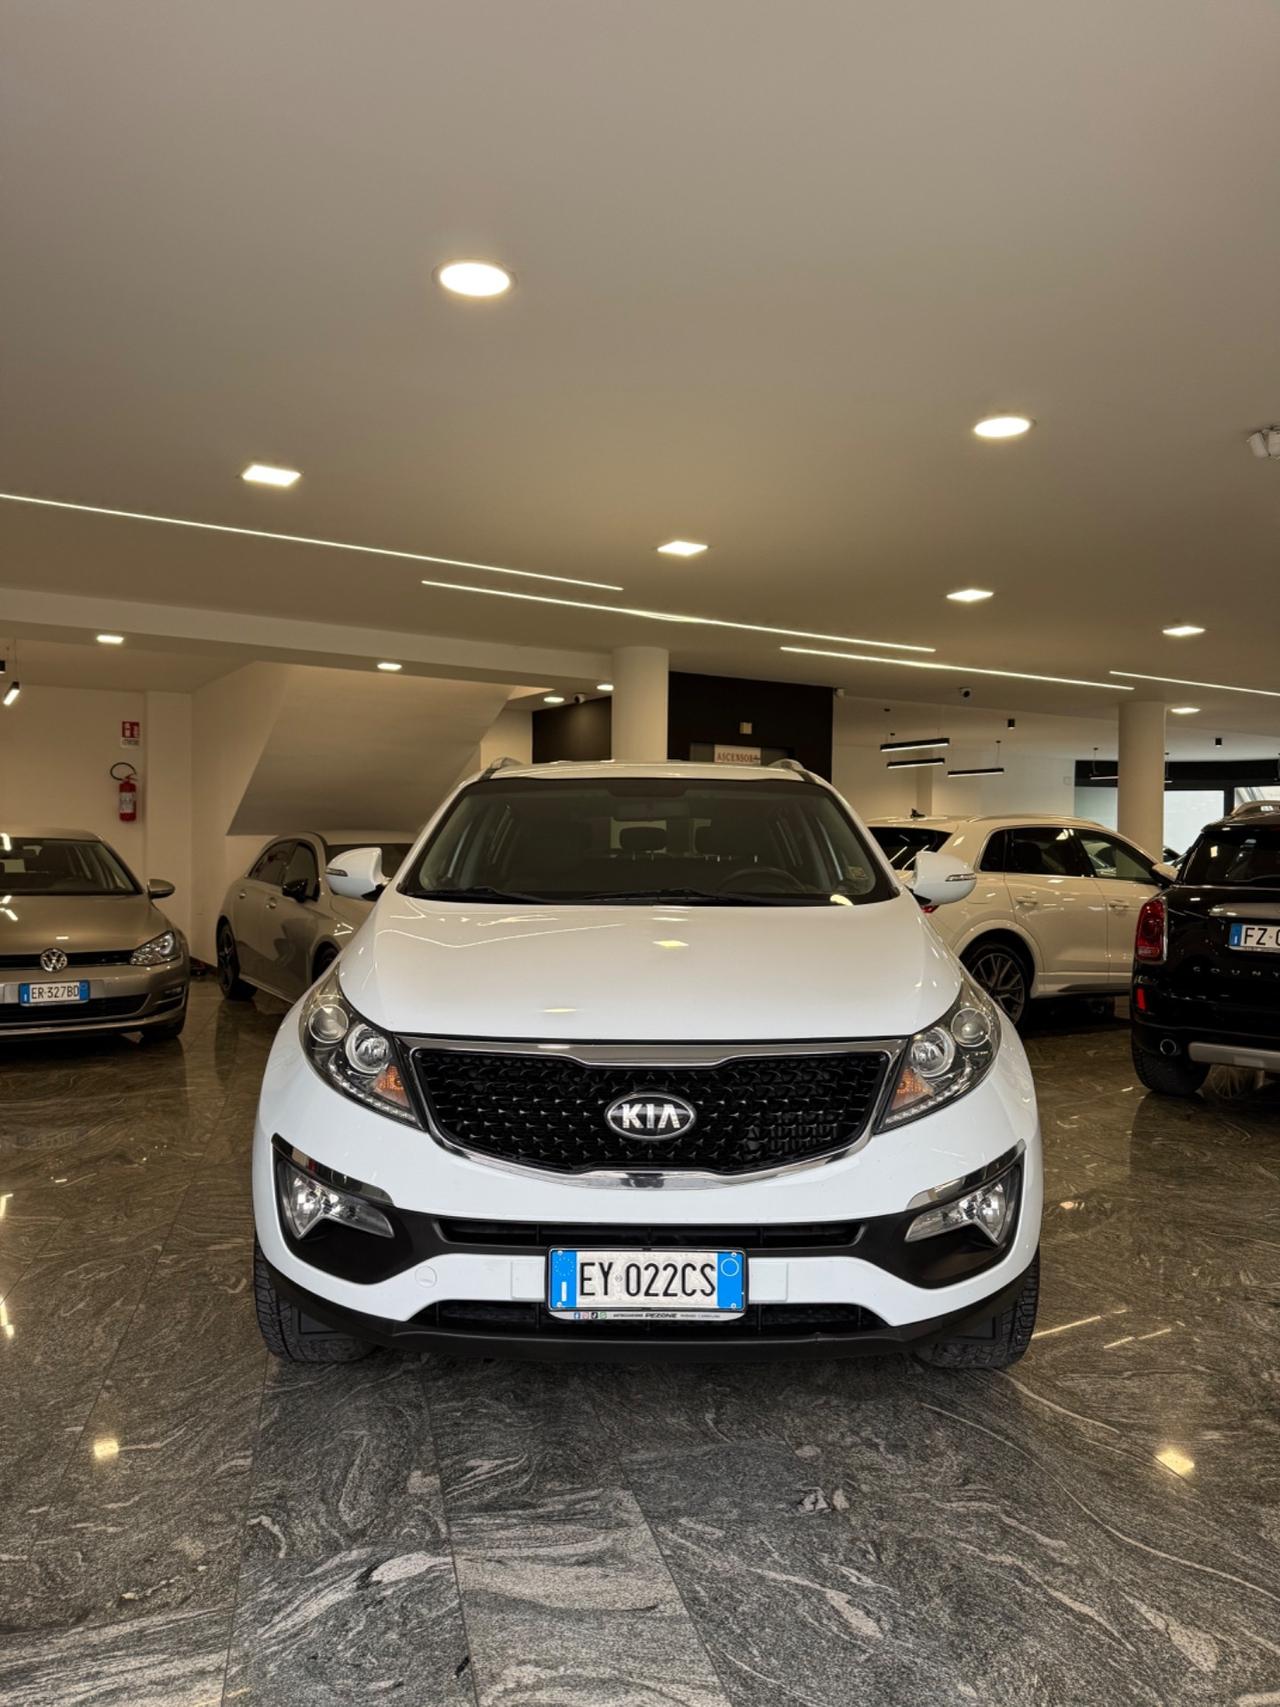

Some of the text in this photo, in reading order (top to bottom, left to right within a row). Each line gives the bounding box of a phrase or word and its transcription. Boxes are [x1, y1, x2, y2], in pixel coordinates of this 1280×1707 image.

[1244, 927, 1268, 946] FZ
[621, 1103, 680, 1129] KIA
[579, 1262, 716, 1297] EY 022CS
